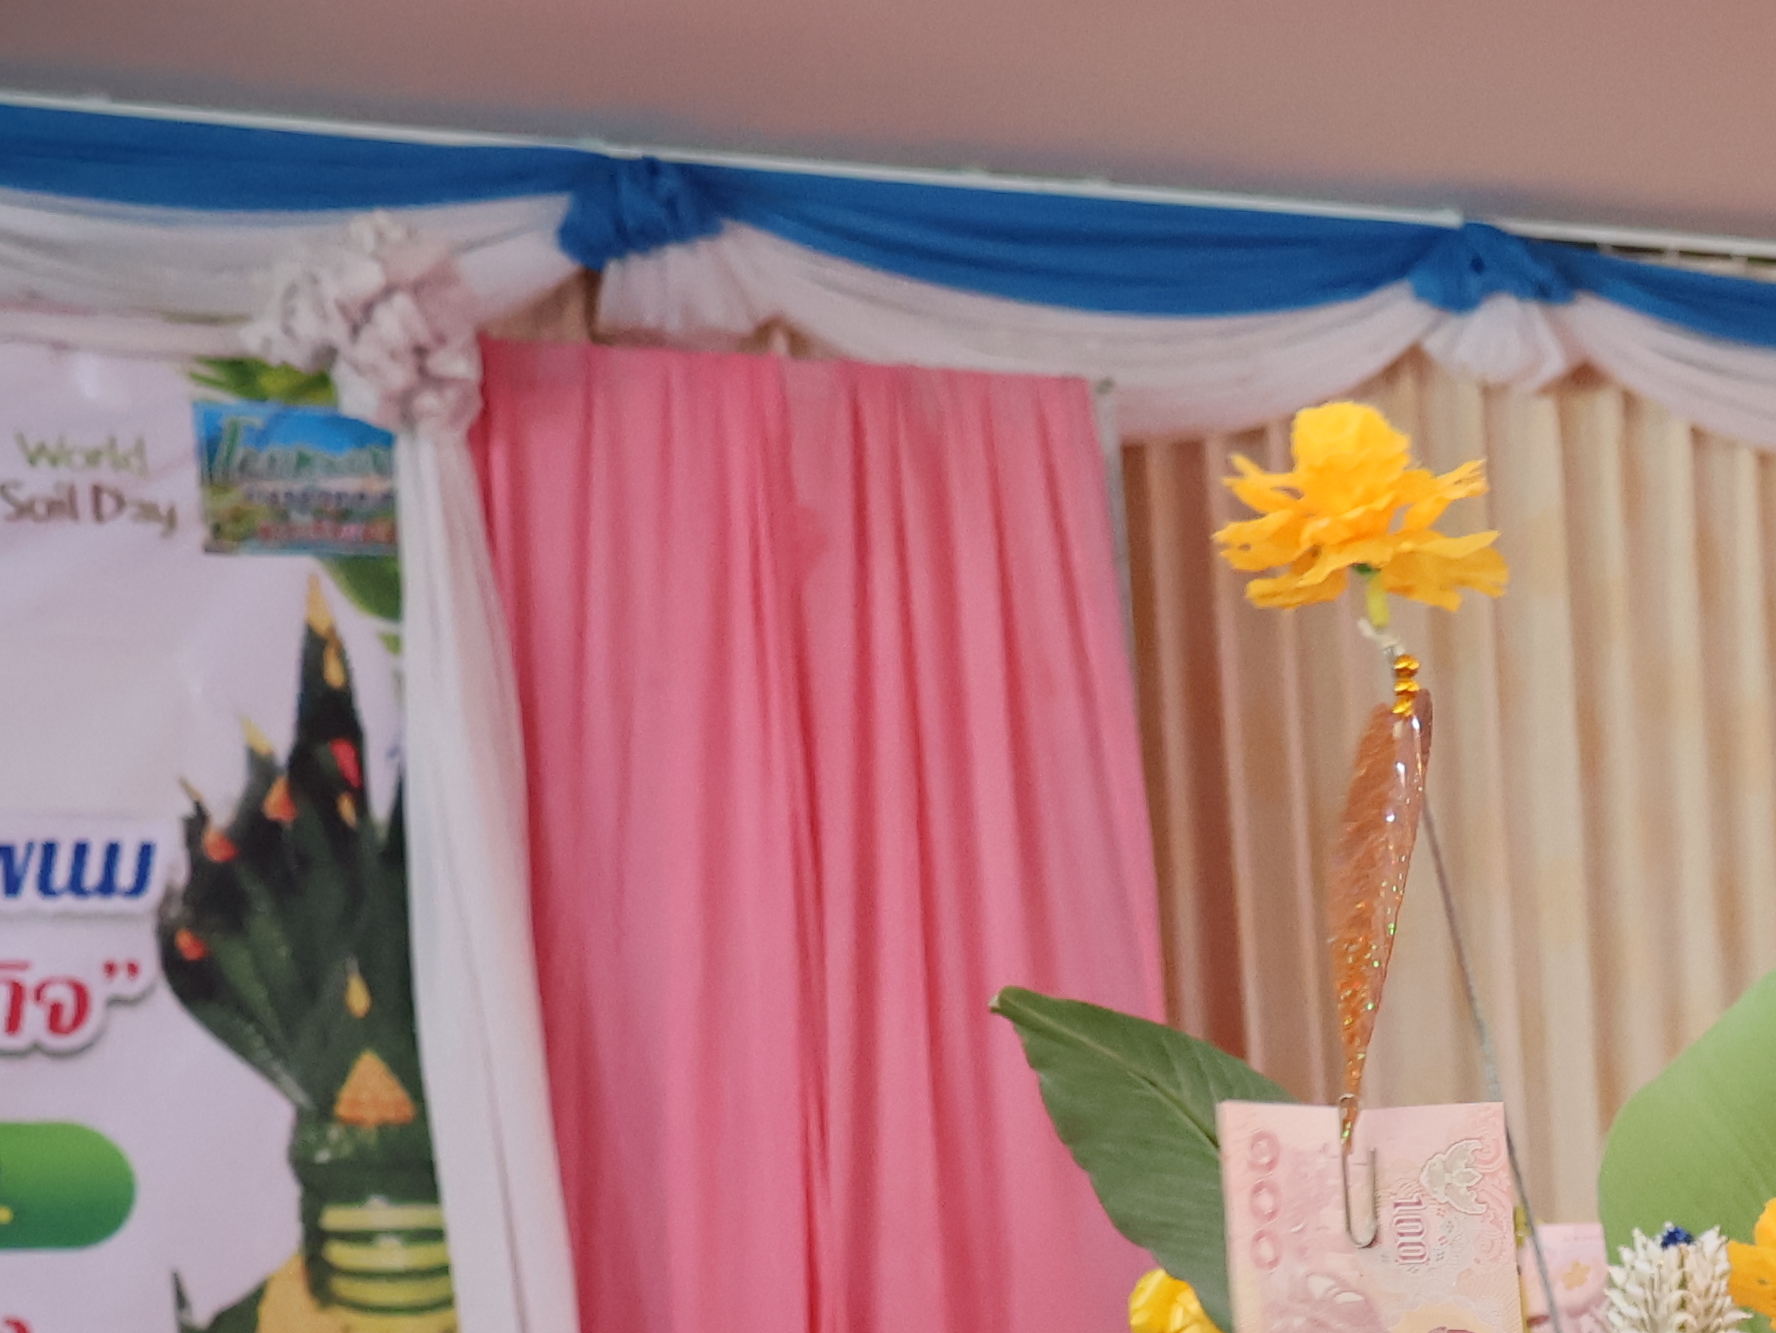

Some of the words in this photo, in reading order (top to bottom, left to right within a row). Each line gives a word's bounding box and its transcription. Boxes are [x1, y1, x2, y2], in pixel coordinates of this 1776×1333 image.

[14, 431, 150, 479] World
[91, 483, 178, 539] Day
[1392, 1193, 1430, 1266] 100
